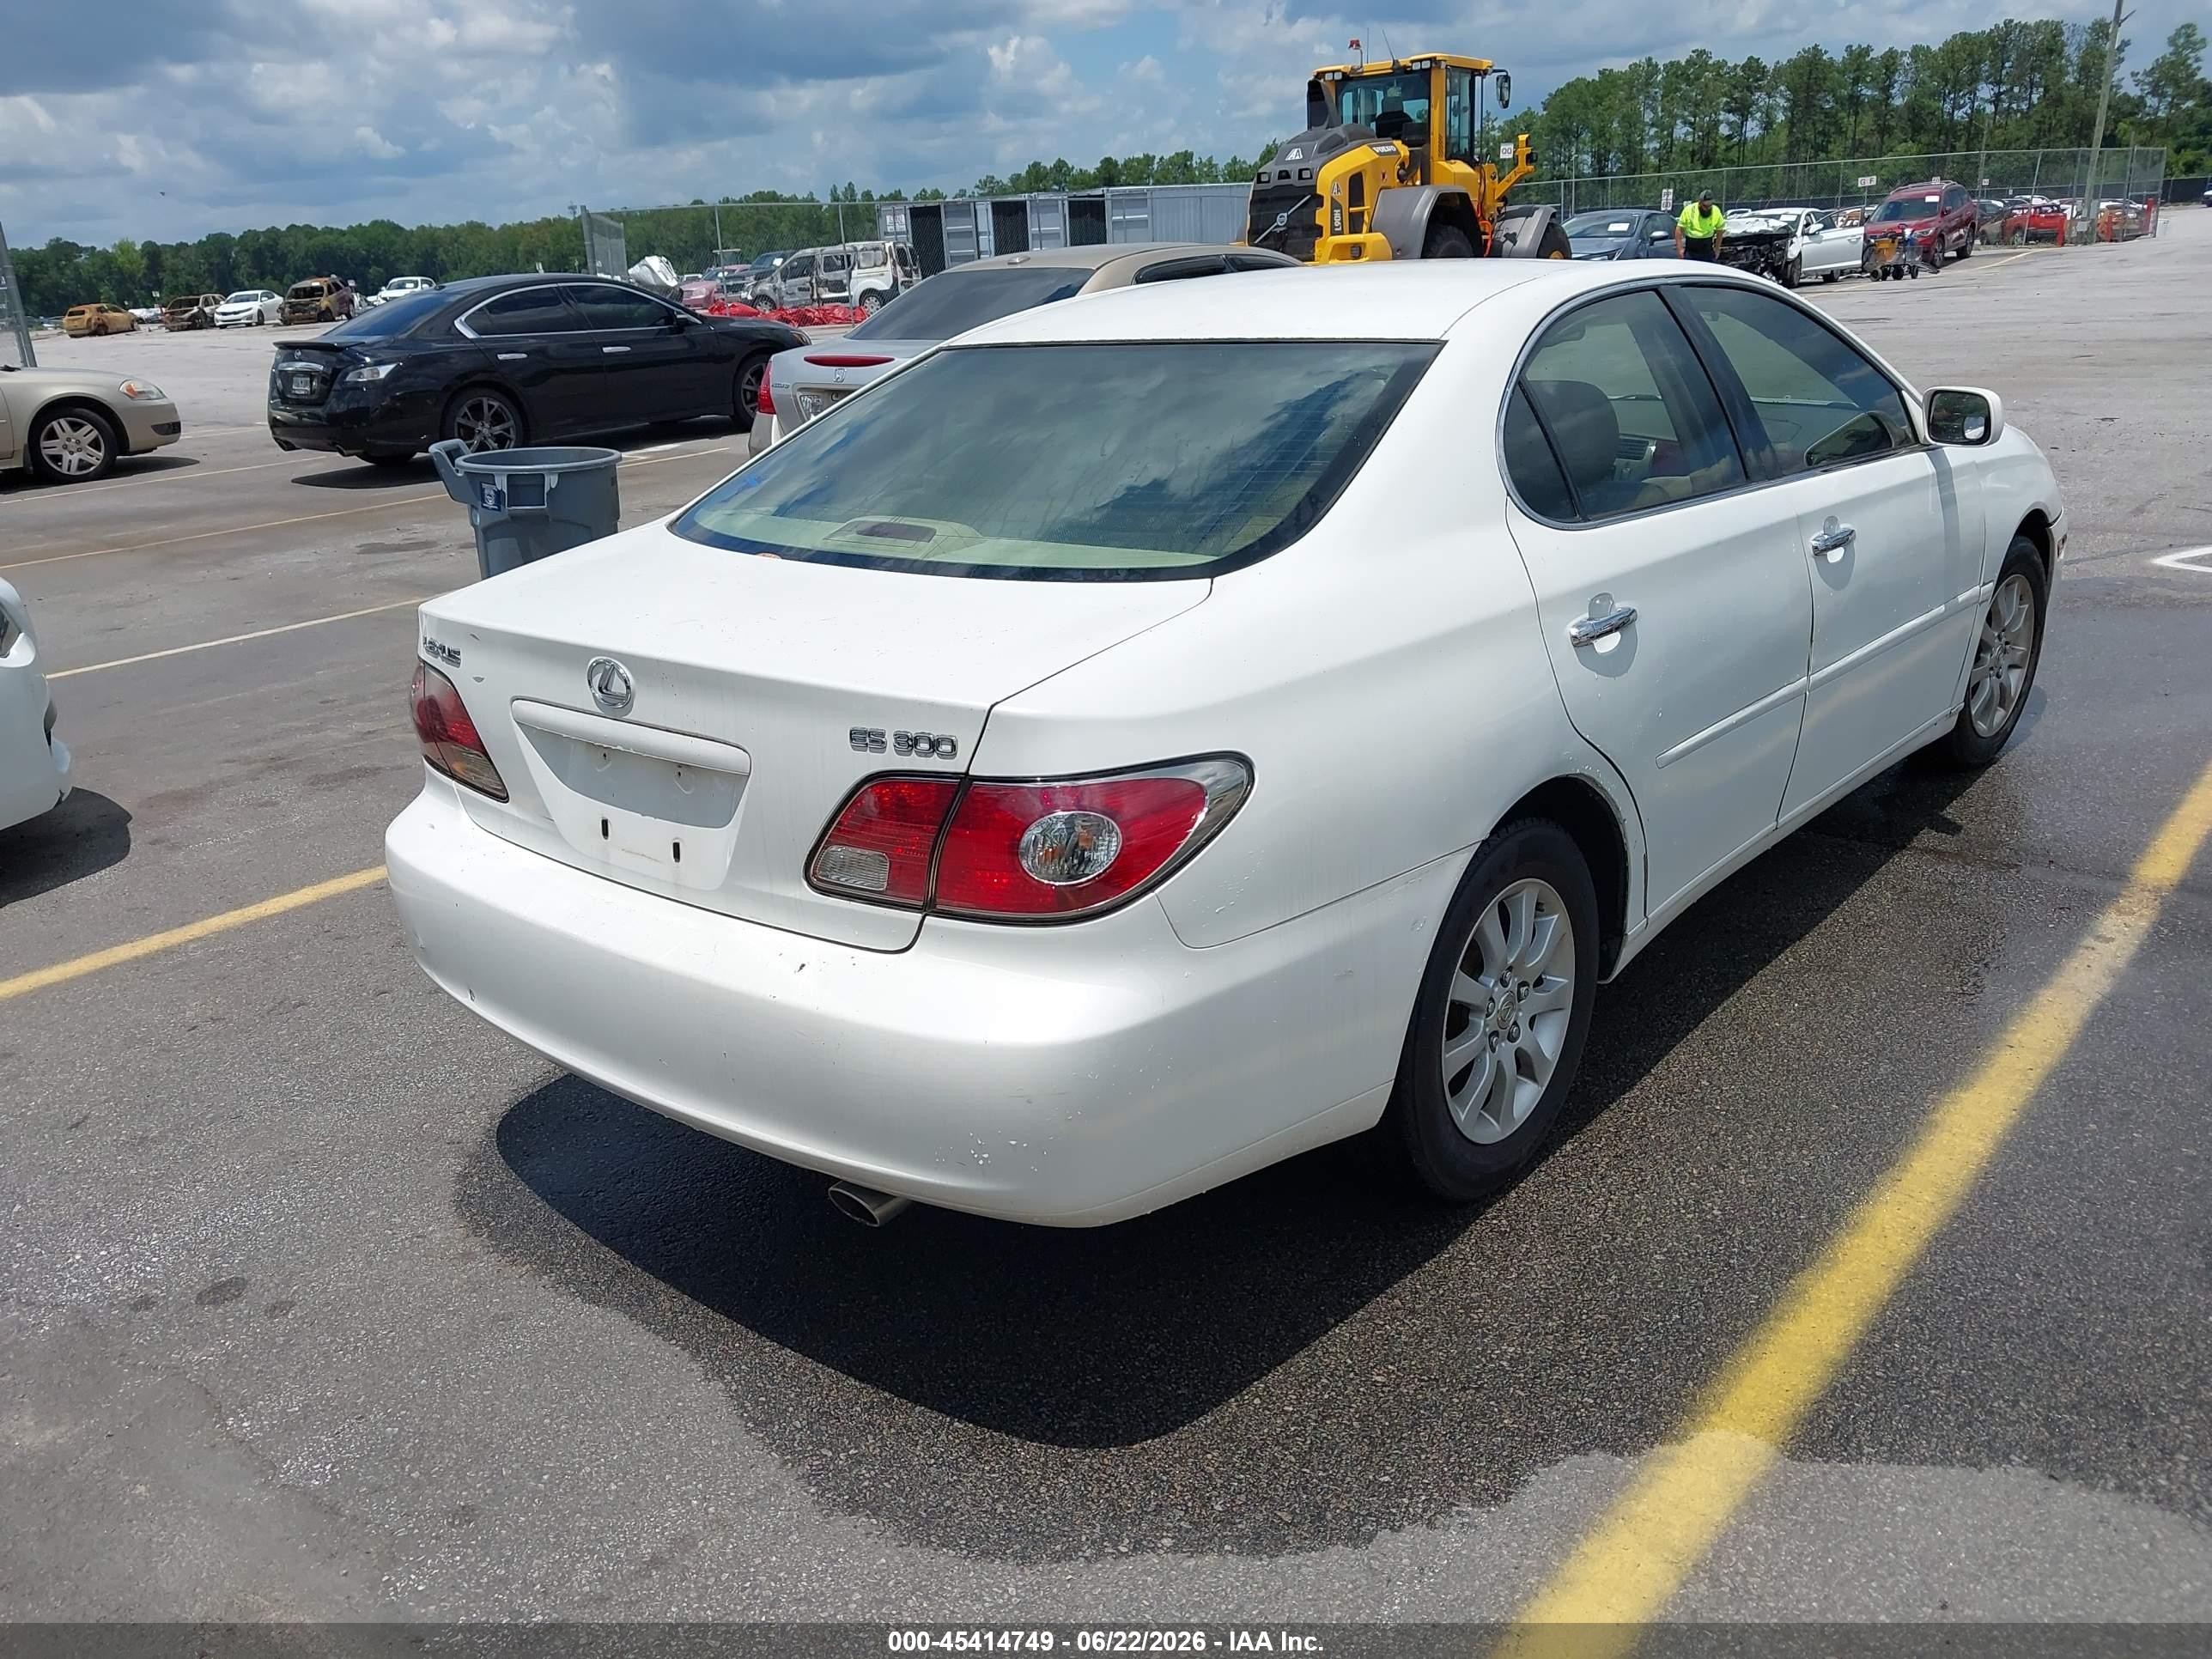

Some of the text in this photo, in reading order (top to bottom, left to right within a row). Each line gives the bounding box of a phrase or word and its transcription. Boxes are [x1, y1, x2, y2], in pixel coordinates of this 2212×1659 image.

[1333, 209, 1343, 231] L90H
[849, 727, 958, 758] ES 300
